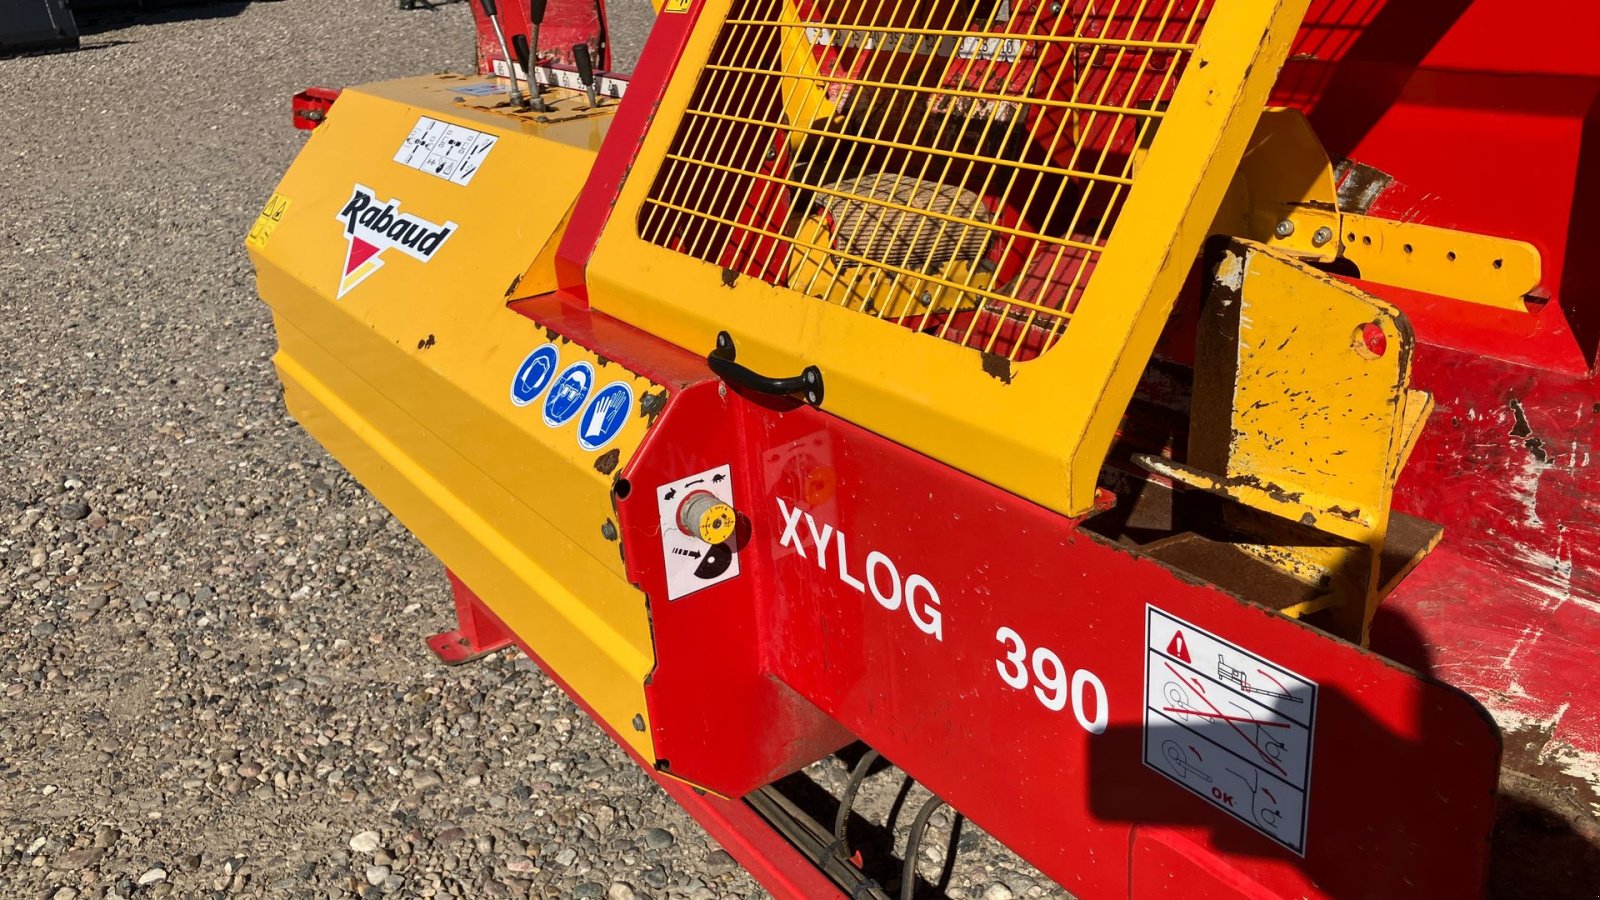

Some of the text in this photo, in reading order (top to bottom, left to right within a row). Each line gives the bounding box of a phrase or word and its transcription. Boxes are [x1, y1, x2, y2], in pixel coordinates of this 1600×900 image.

[341, 190, 451, 256] Rabaud
[776, 496, 1109, 735] XYLOG 390
[1211, 786, 1234, 807] OK
